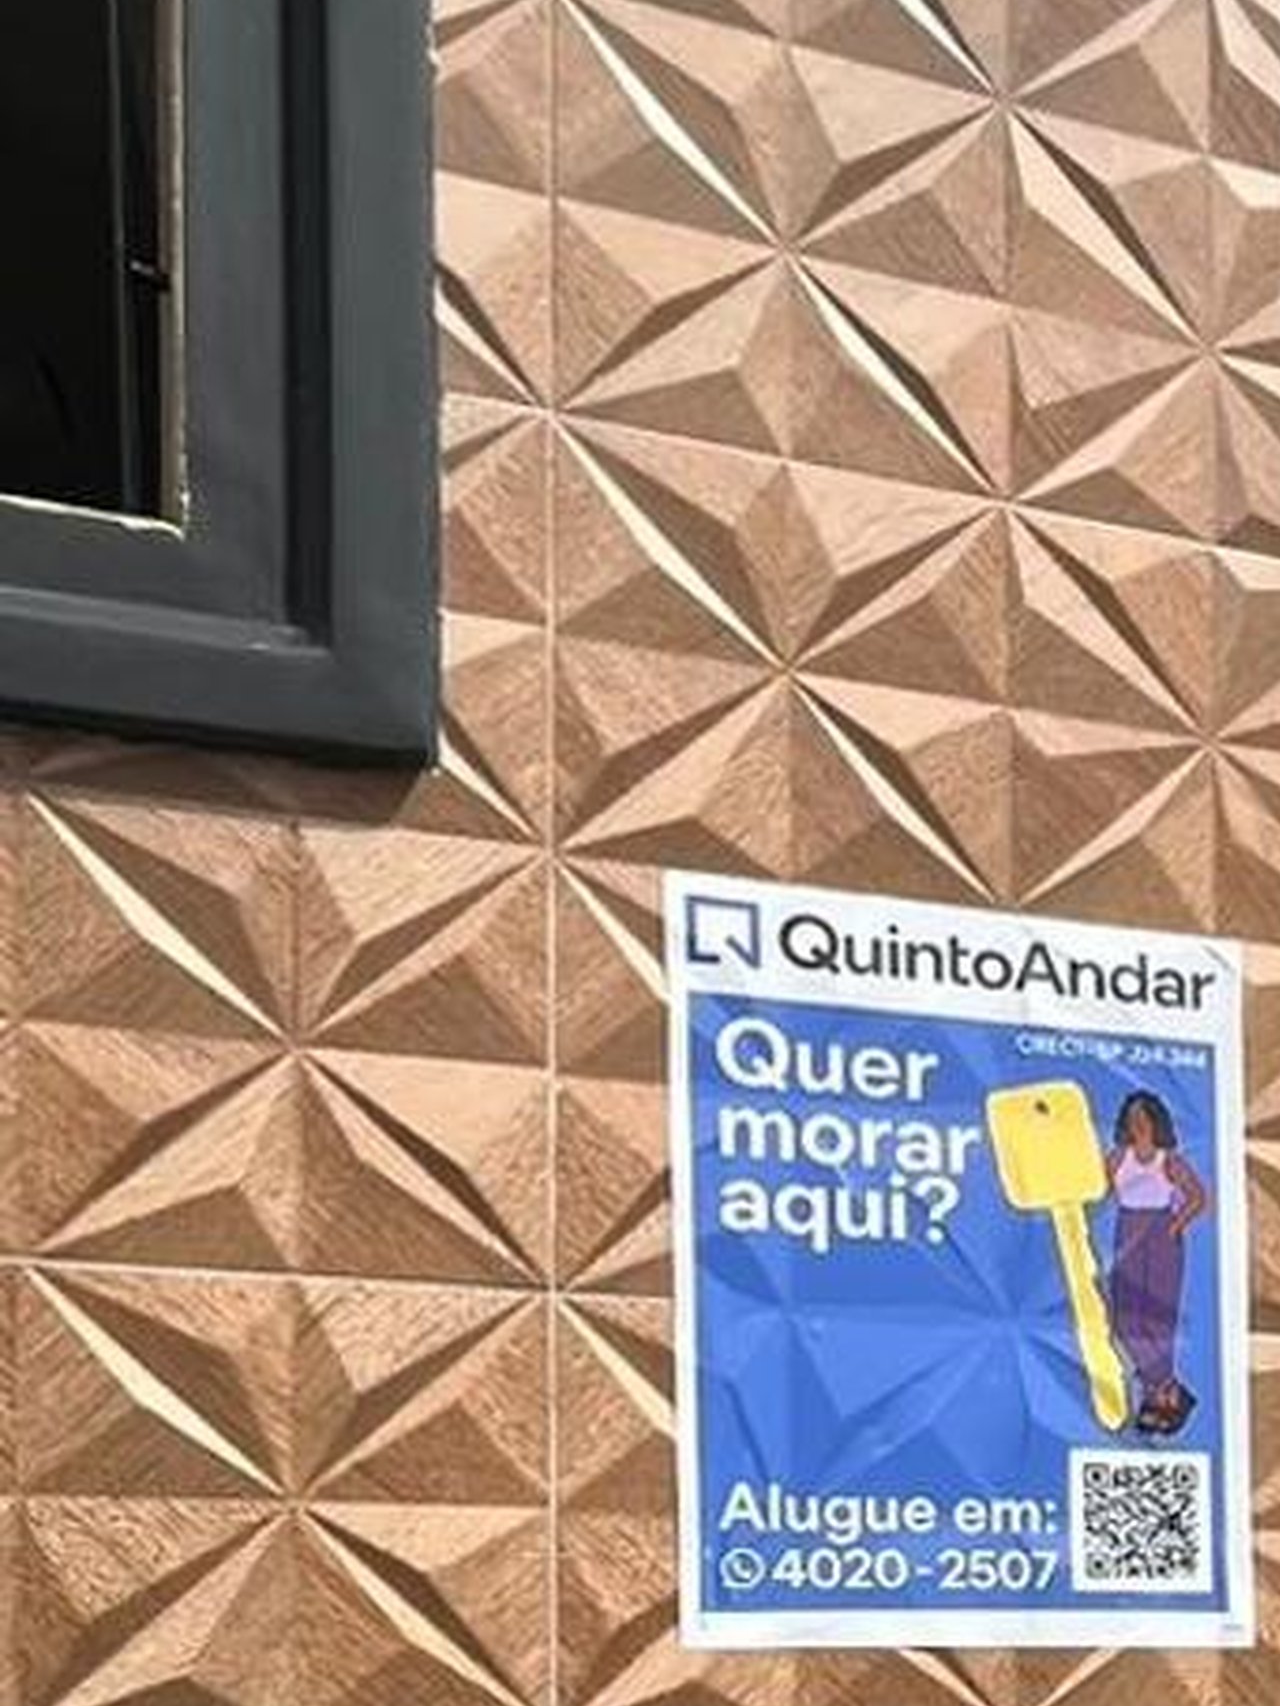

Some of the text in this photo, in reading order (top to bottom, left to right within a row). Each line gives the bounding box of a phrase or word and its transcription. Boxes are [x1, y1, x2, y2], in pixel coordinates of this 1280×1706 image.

[779, 914, 1217, 1010] QuintoAndar
[714, 1017, 940, 1099] Quer
[718, 1105, 981, 1175] morar
[718, 1174, 960, 1252] aqui?
[719, 1482, 1059, 1545] Alugue em:
